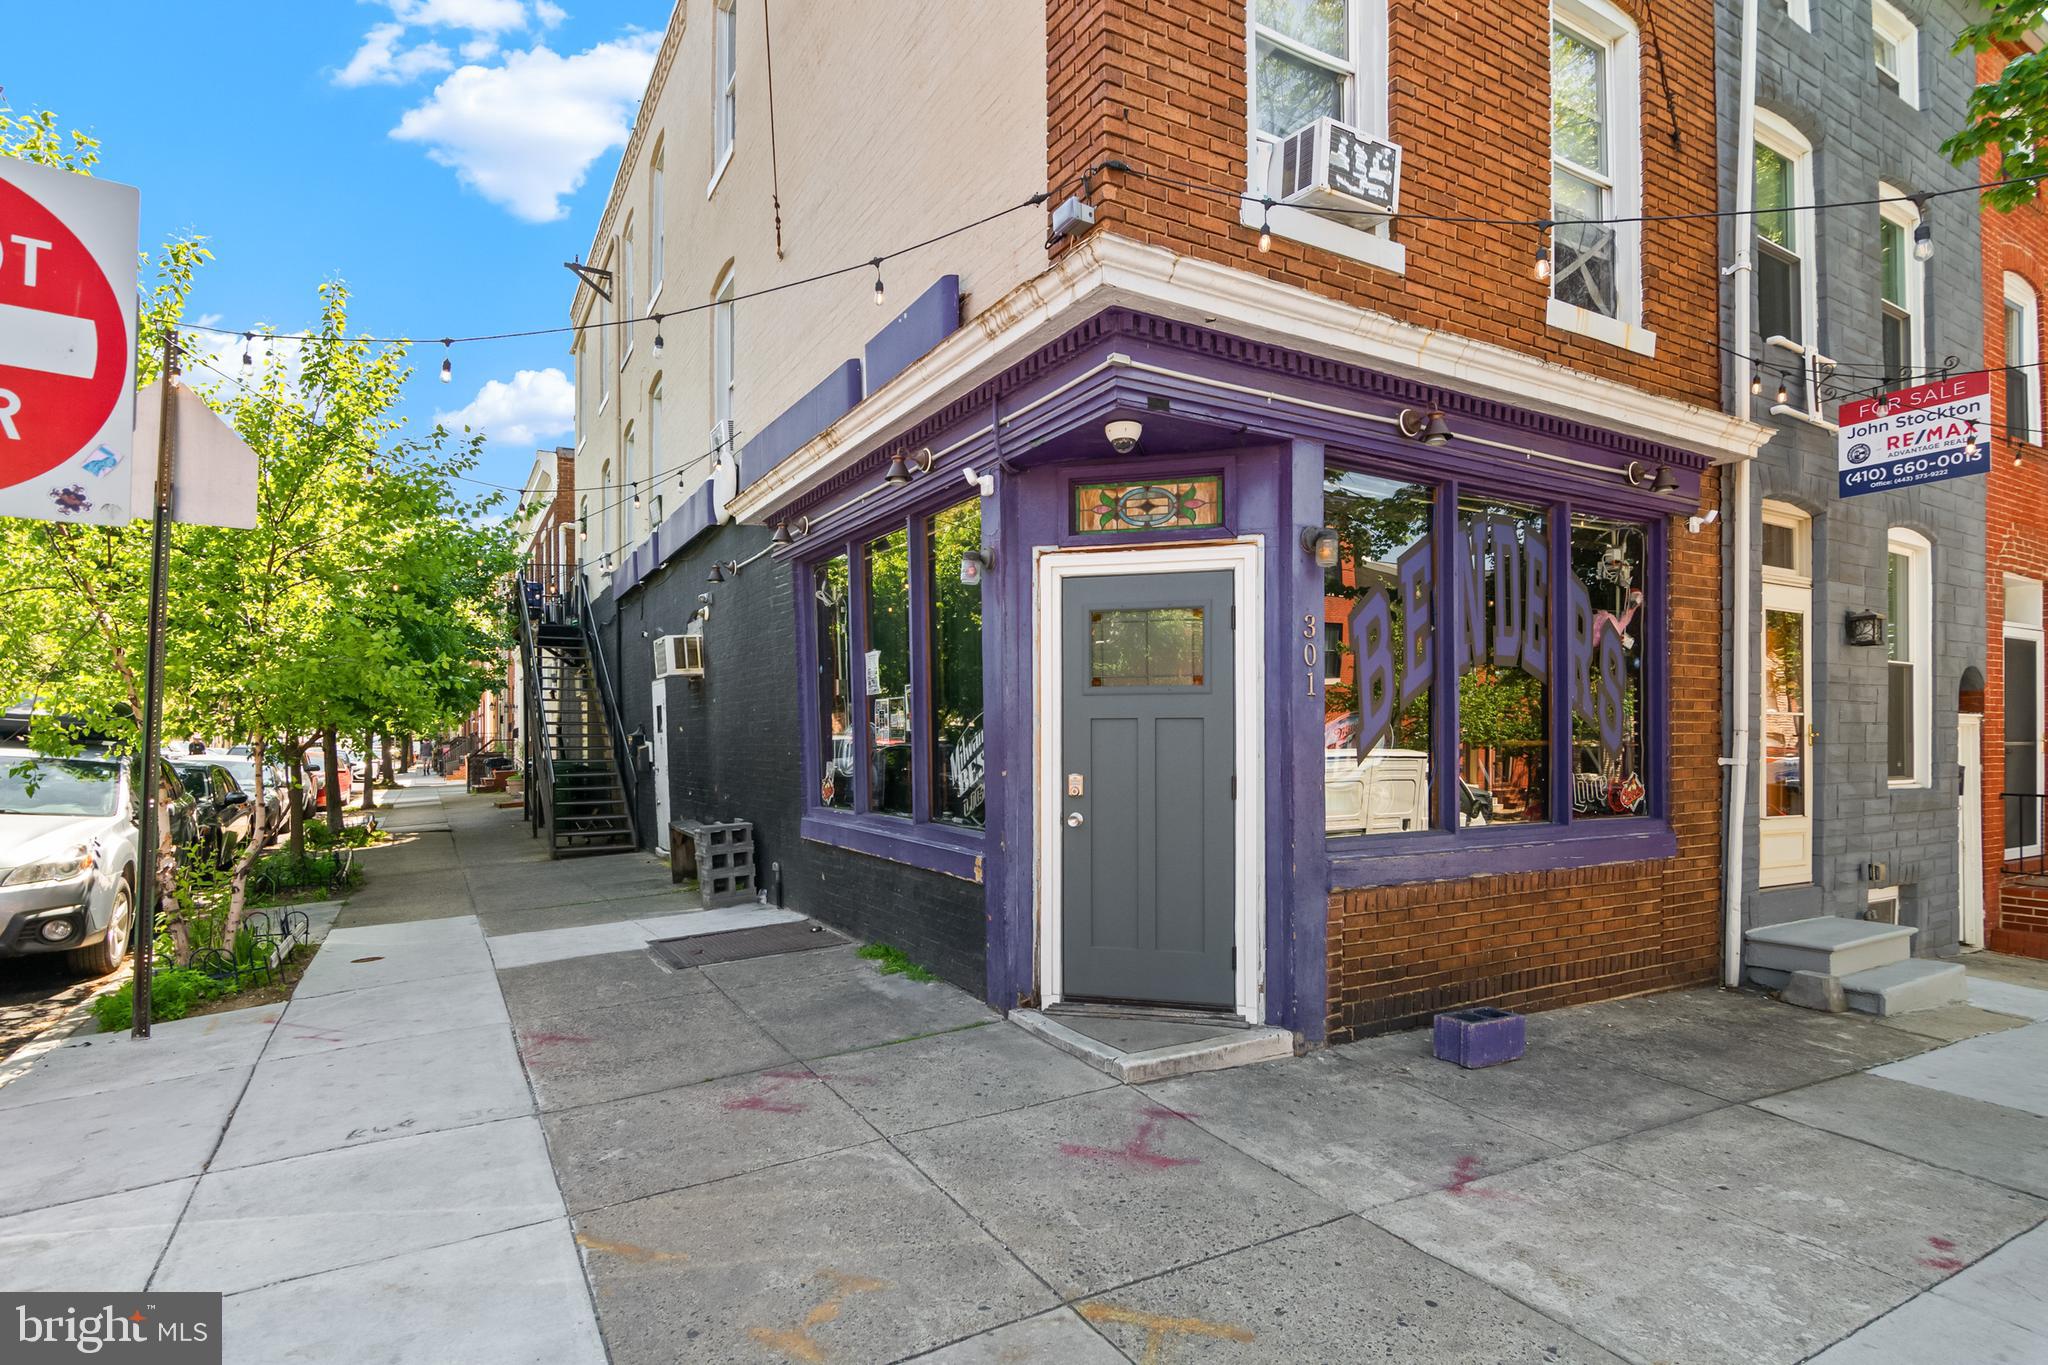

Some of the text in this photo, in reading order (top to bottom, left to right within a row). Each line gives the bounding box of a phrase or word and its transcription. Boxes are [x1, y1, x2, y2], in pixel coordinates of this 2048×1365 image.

[0, 234, 53, 288] T
[1910, 380, 1967, 406] SALE
[1847, 402, 1981, 439] John Stockton
[1887, 420, 1978, 450] RE/MAX
[1887, 443, 1940, 458] ADVANTAGE
[1944, 435, 1978, 447] REAL
[1845, 467, 1887, 486] (410)
[1892, 448, 1983, 476] 660-0013
[1870, 469, 1949, 488] Office: (443) 573-9222
[1303, 614, 1317, 697] 301
[1348, 509, 1627, 766] BENDERS
